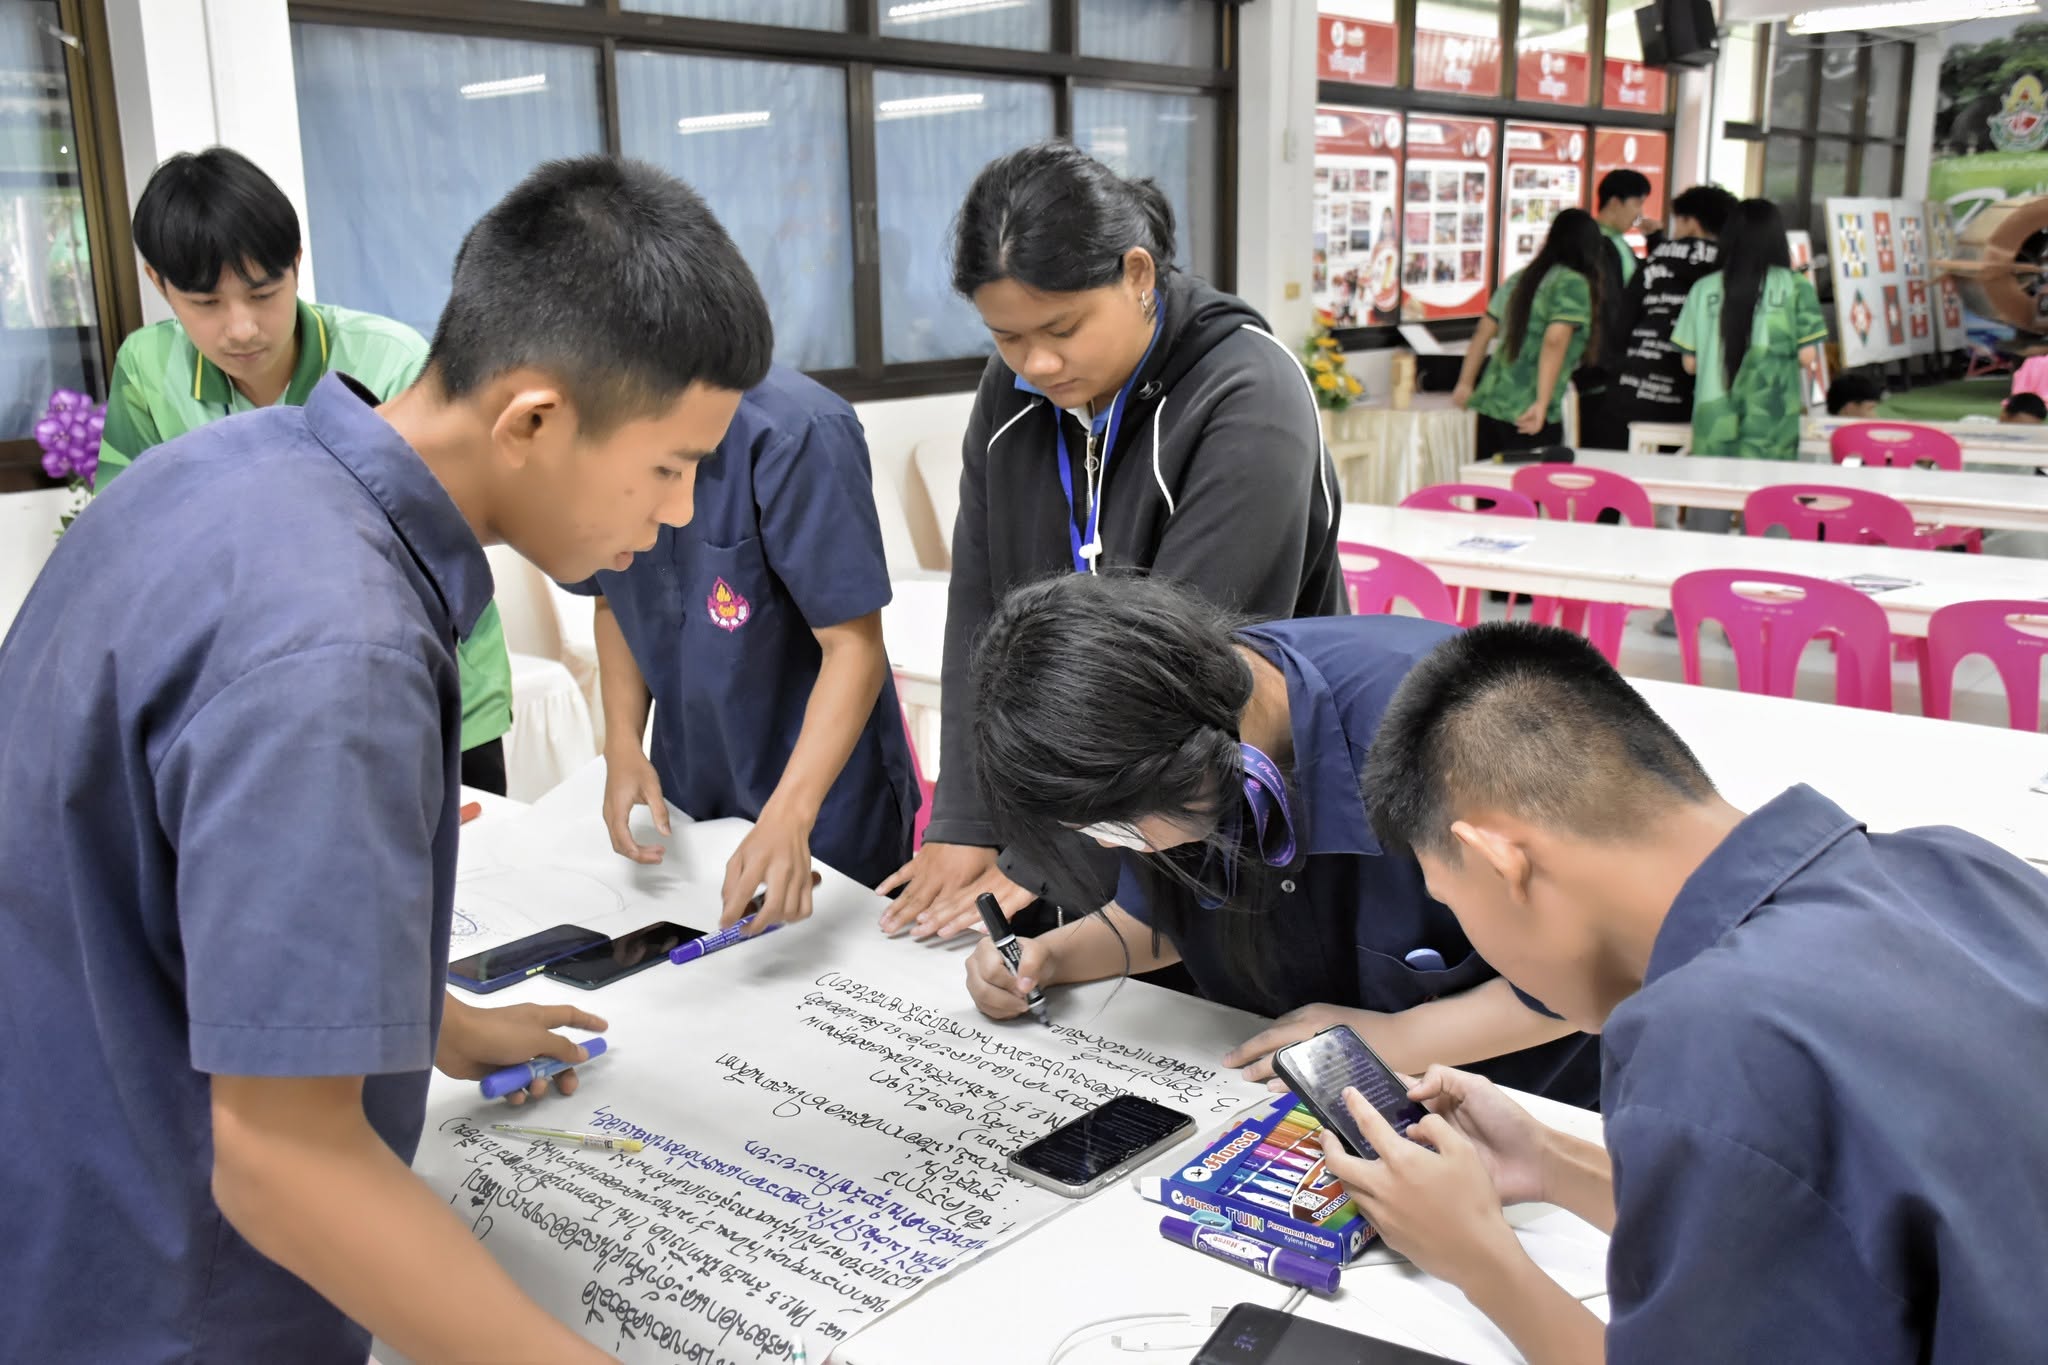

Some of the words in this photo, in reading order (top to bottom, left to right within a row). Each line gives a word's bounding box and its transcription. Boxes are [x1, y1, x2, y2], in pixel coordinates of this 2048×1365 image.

[1201, 1130, 1261, 1172] Horse
[1183, 1195, 1221, 1214] Horse
[1226, 1206, 1264, 1233] TWIN
[1267, 1219, 1306, 1237] Permanent
[1305, 1232, 1335, 1249] Markers
[1312, 1192, 1351, 1221] Perman
[1283, 1234, 1304, 1247] Xylene
[1304, 1241, 1318, 1251] Free
